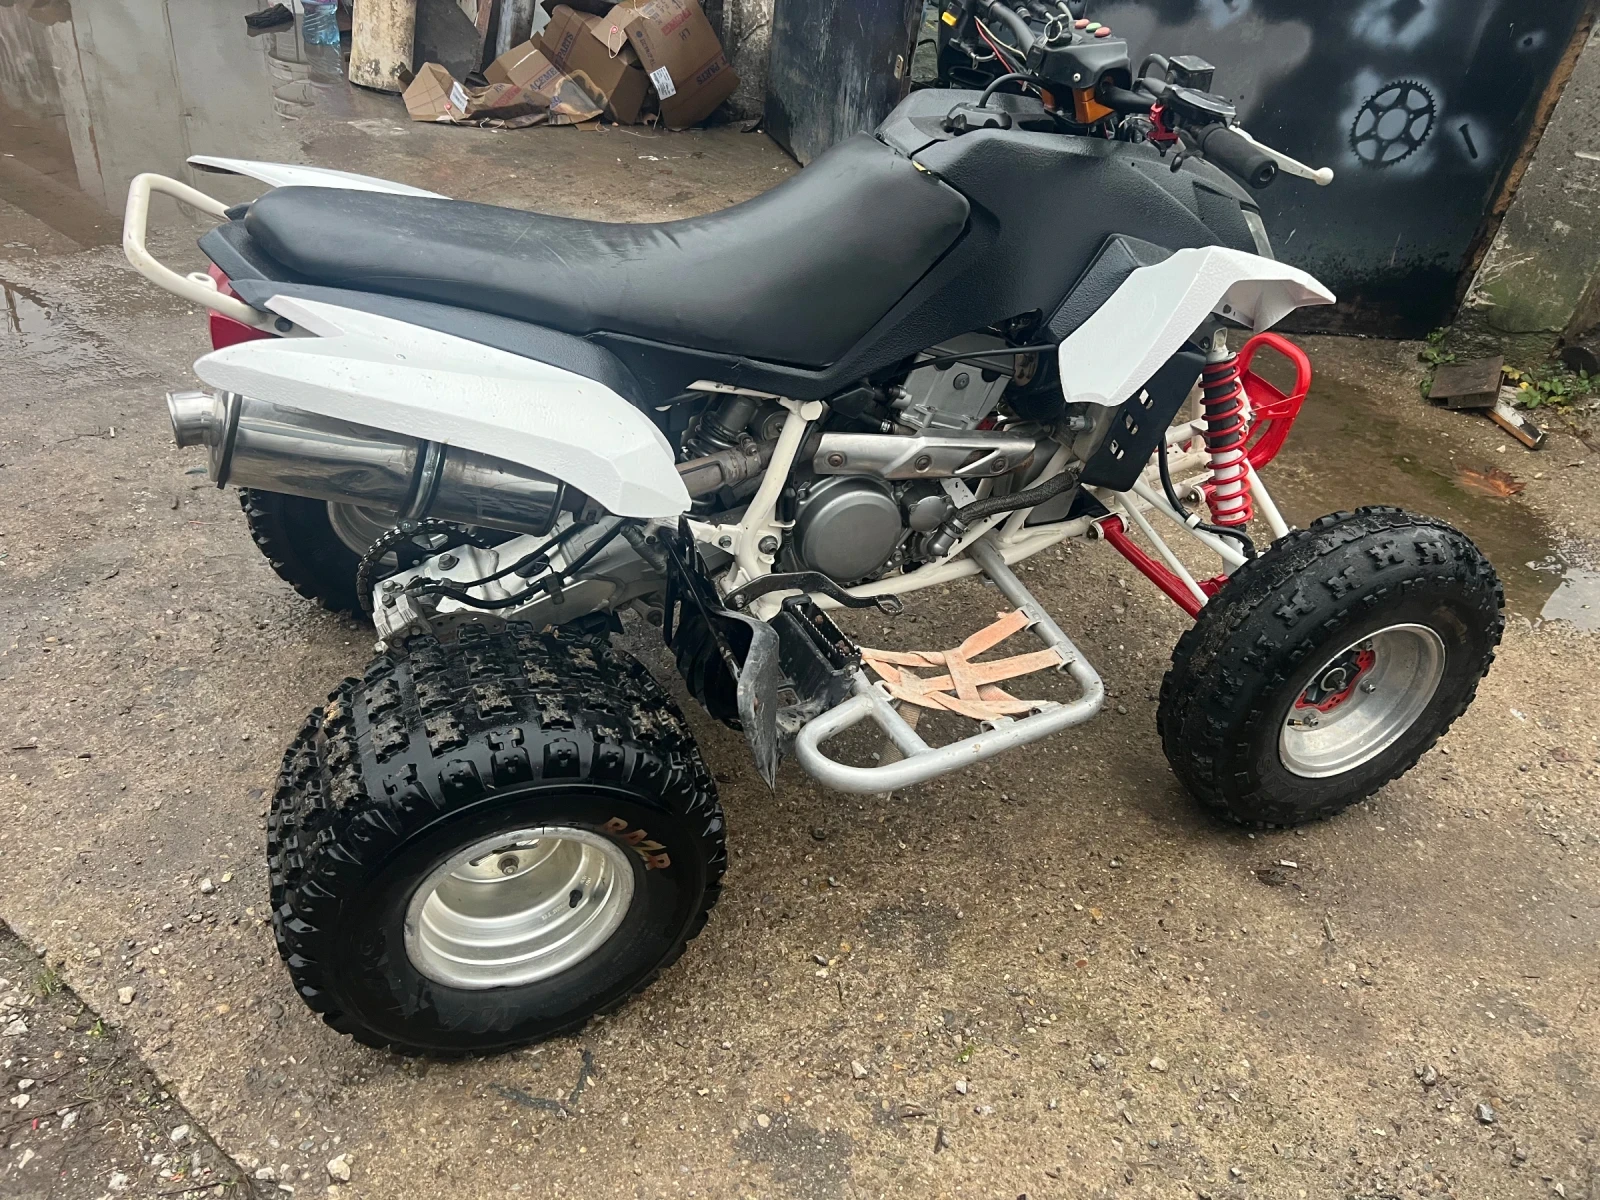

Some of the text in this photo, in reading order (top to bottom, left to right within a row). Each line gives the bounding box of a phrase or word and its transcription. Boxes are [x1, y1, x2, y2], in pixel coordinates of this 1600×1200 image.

[558, 33, 574, 62] PARTS
[696, 62, 721, 85] PARTS
[604, 816, 671, 870] RAZR
